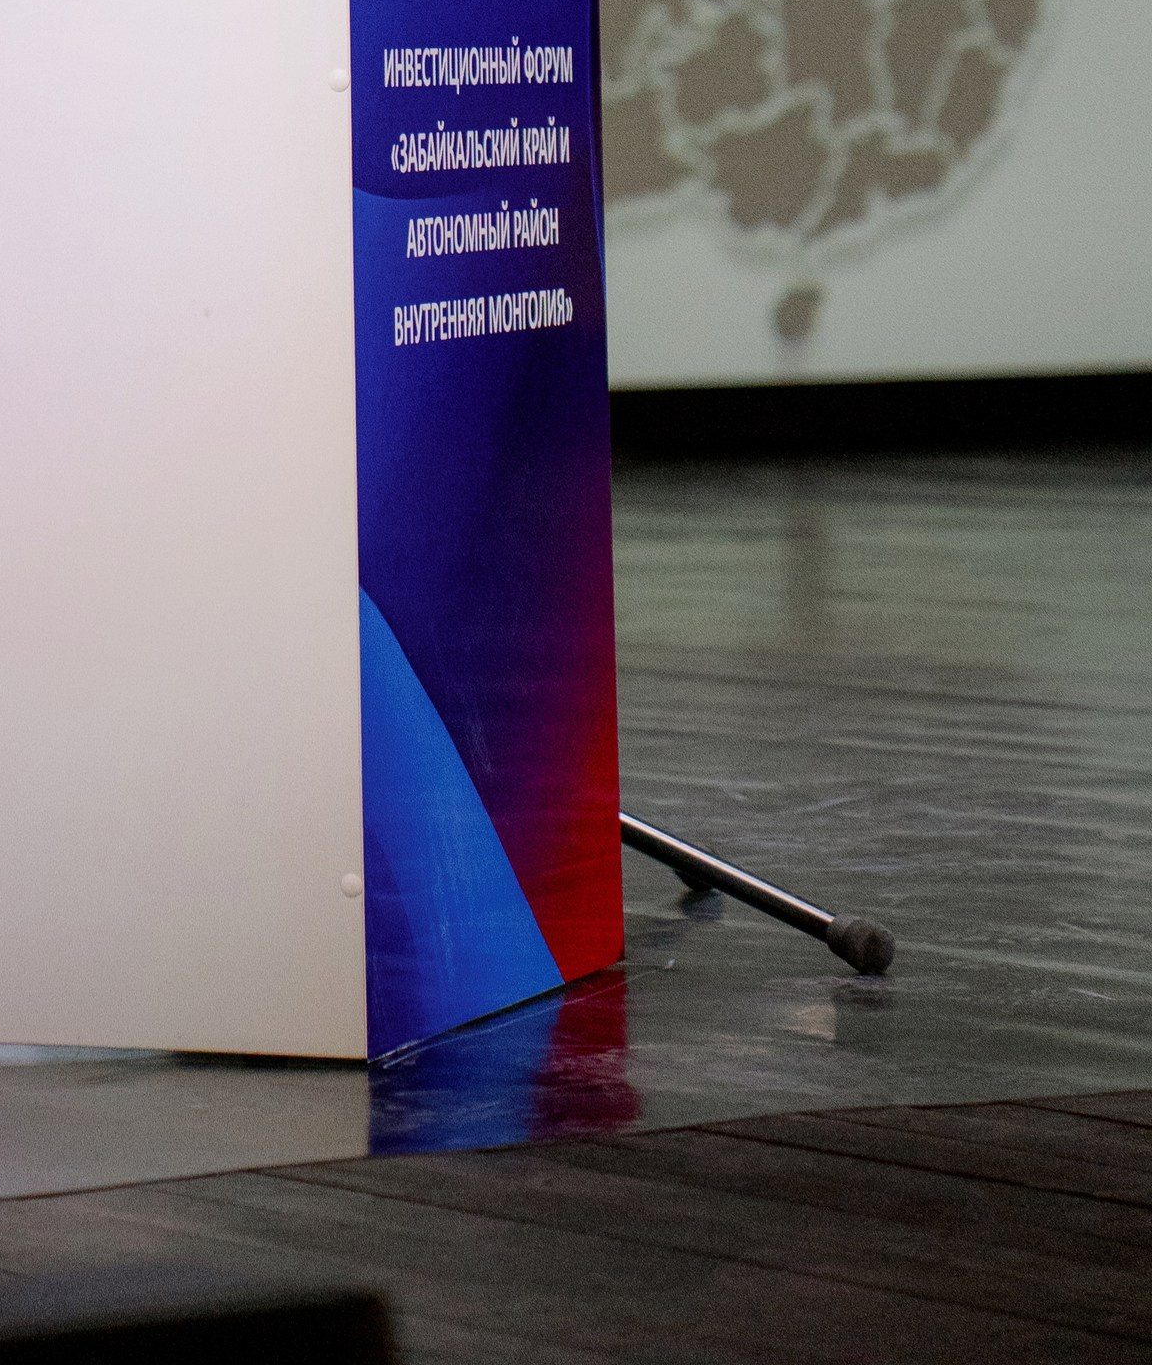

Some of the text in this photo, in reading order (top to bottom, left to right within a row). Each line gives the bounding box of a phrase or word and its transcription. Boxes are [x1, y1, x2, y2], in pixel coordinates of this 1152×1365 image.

[384, 36, 573, 95] ИНВЕСТИЦИОННЫЙ ФОРУМ
[391, 116, 570, 173] «ЗАБАЙКАЛЬСКИЙ КРАЙ И
[406, 198, 559, 258] АВТОНОМНЫЙ РАЙОН
[394, 288, 573, 347] ВНУТРЕННЯЯ МОНГОЛИЯ»
